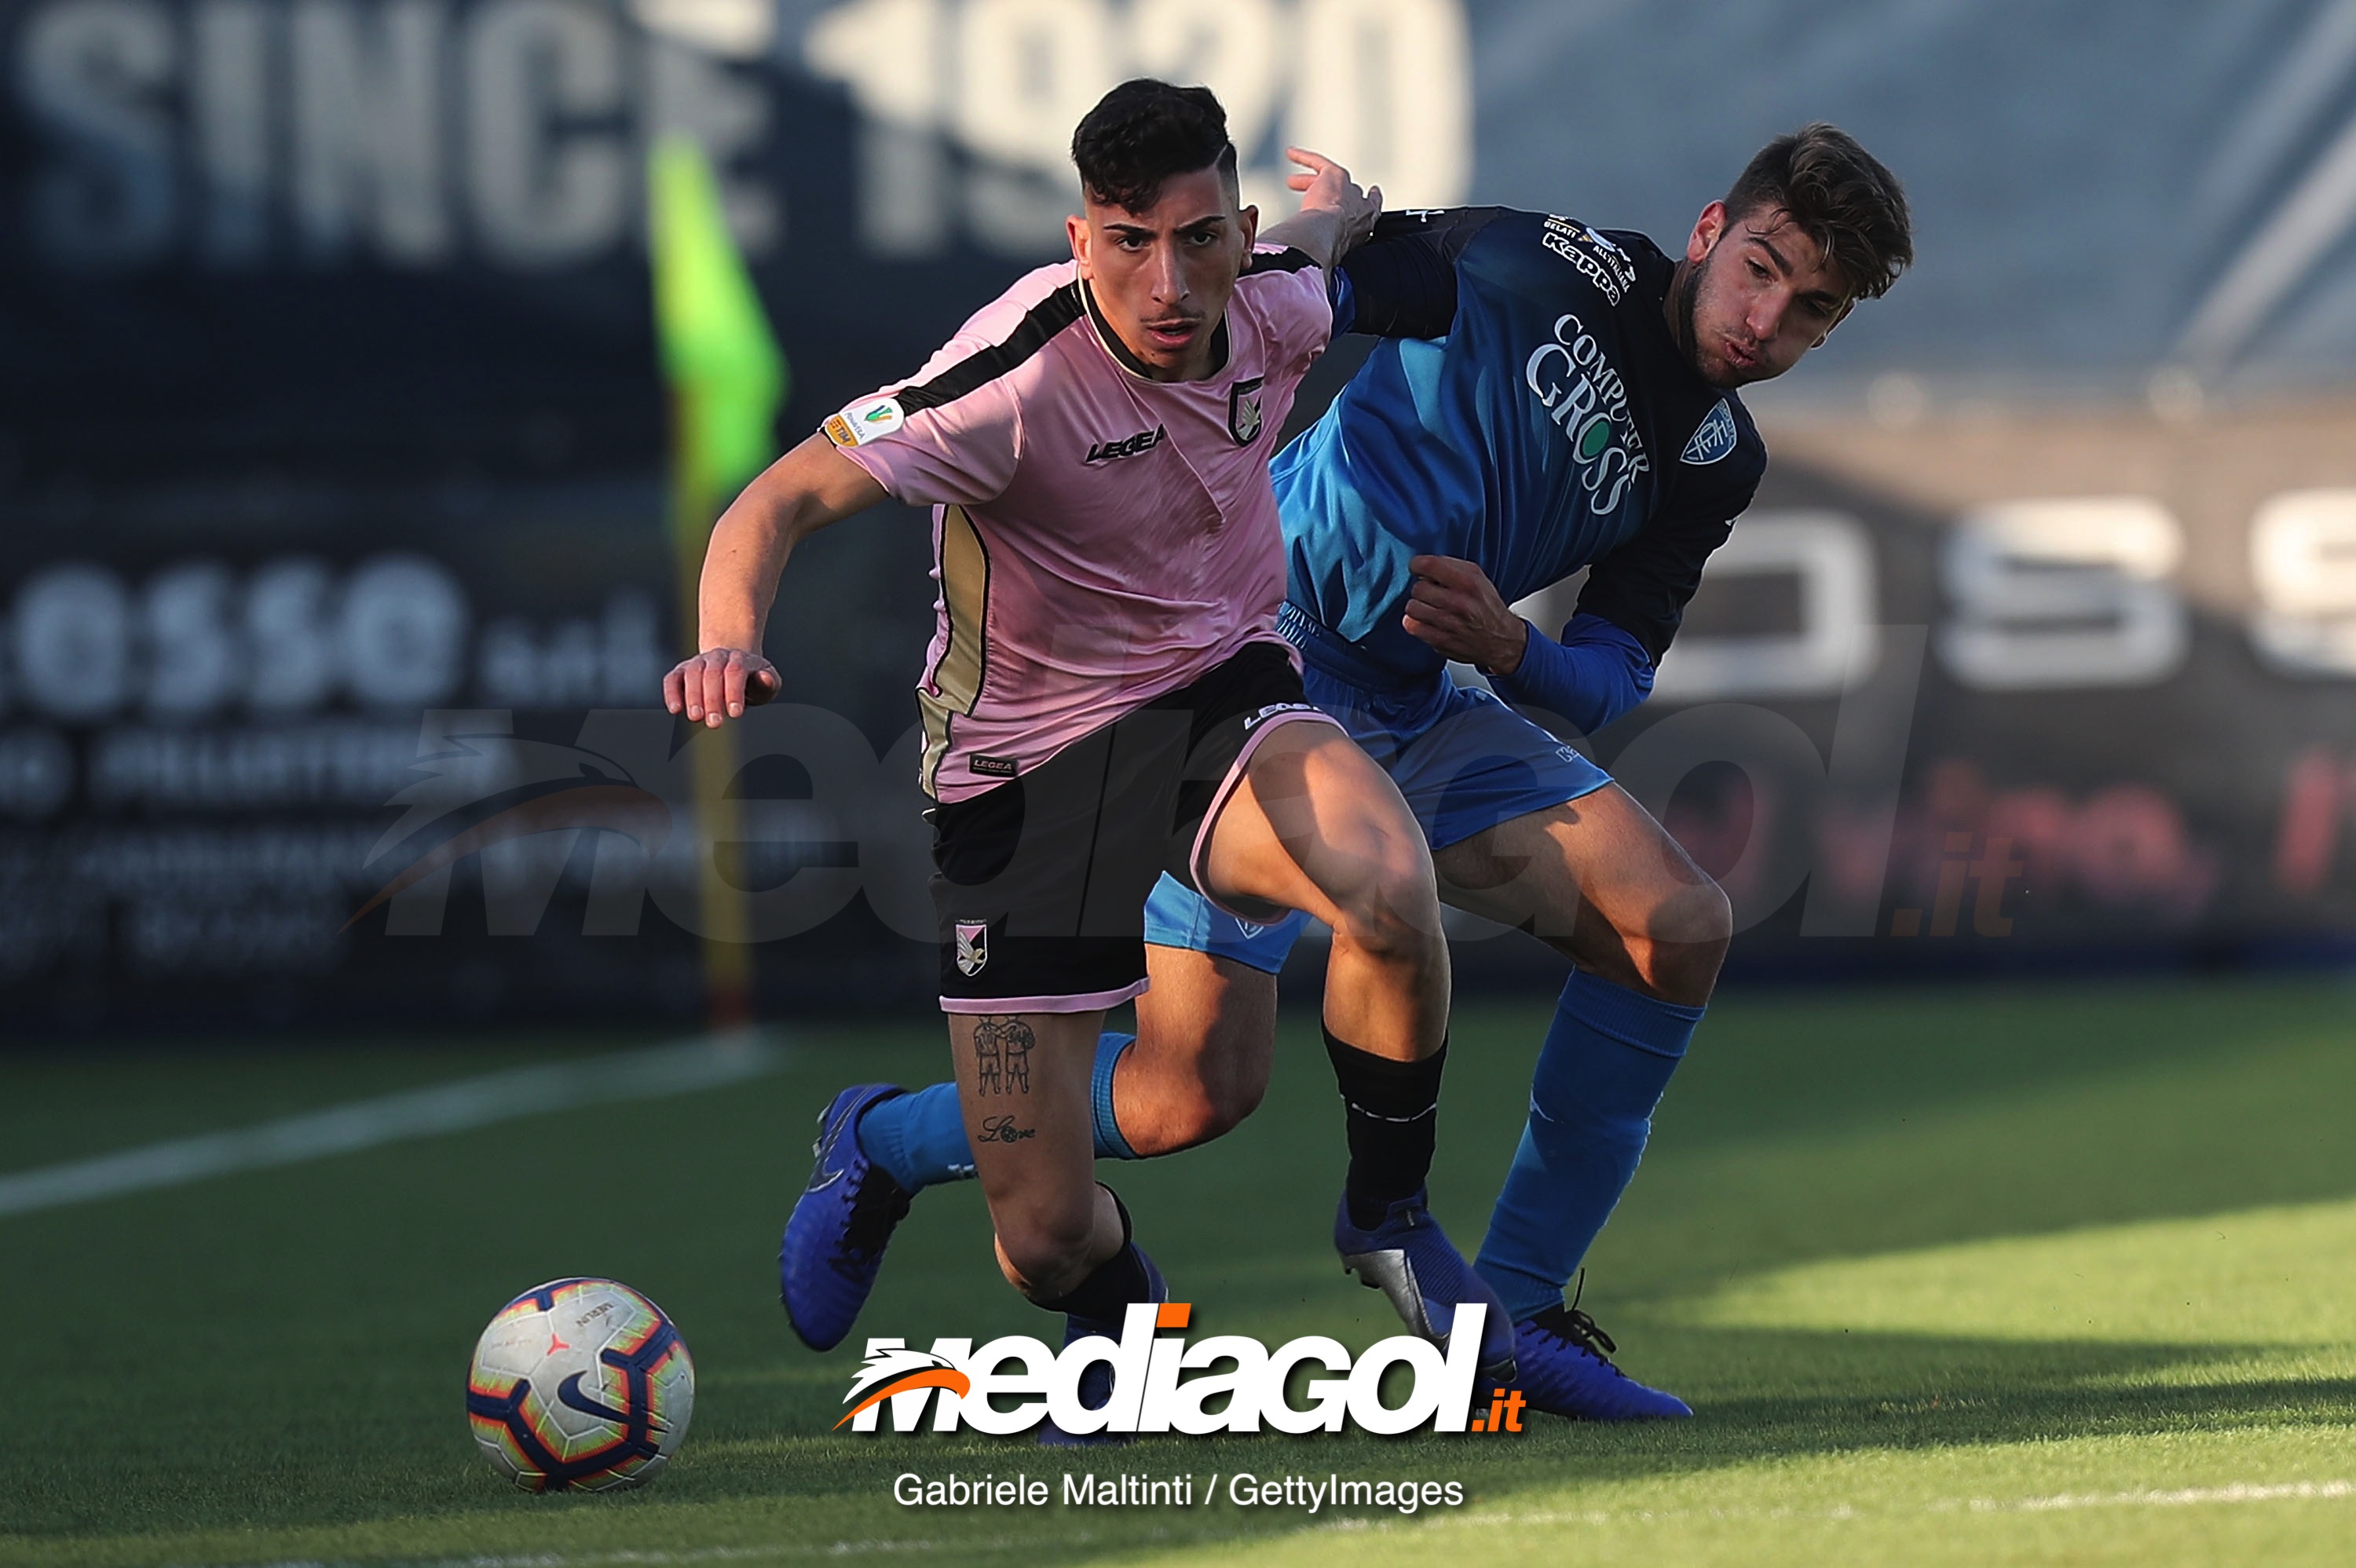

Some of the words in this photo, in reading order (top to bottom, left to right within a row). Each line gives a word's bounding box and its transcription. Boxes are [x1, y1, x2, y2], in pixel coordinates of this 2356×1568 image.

[20, 0, 777, 269] SINCE
[1085, 422, 1165, 463] LEGEA
[1526, 343, 1632, 516] GROSS
[1553, 314, 1650, 484] COMPUTER
[974, 759, 1012, 770] LEGEA
[978, 1115, 1036, 1143] Love
